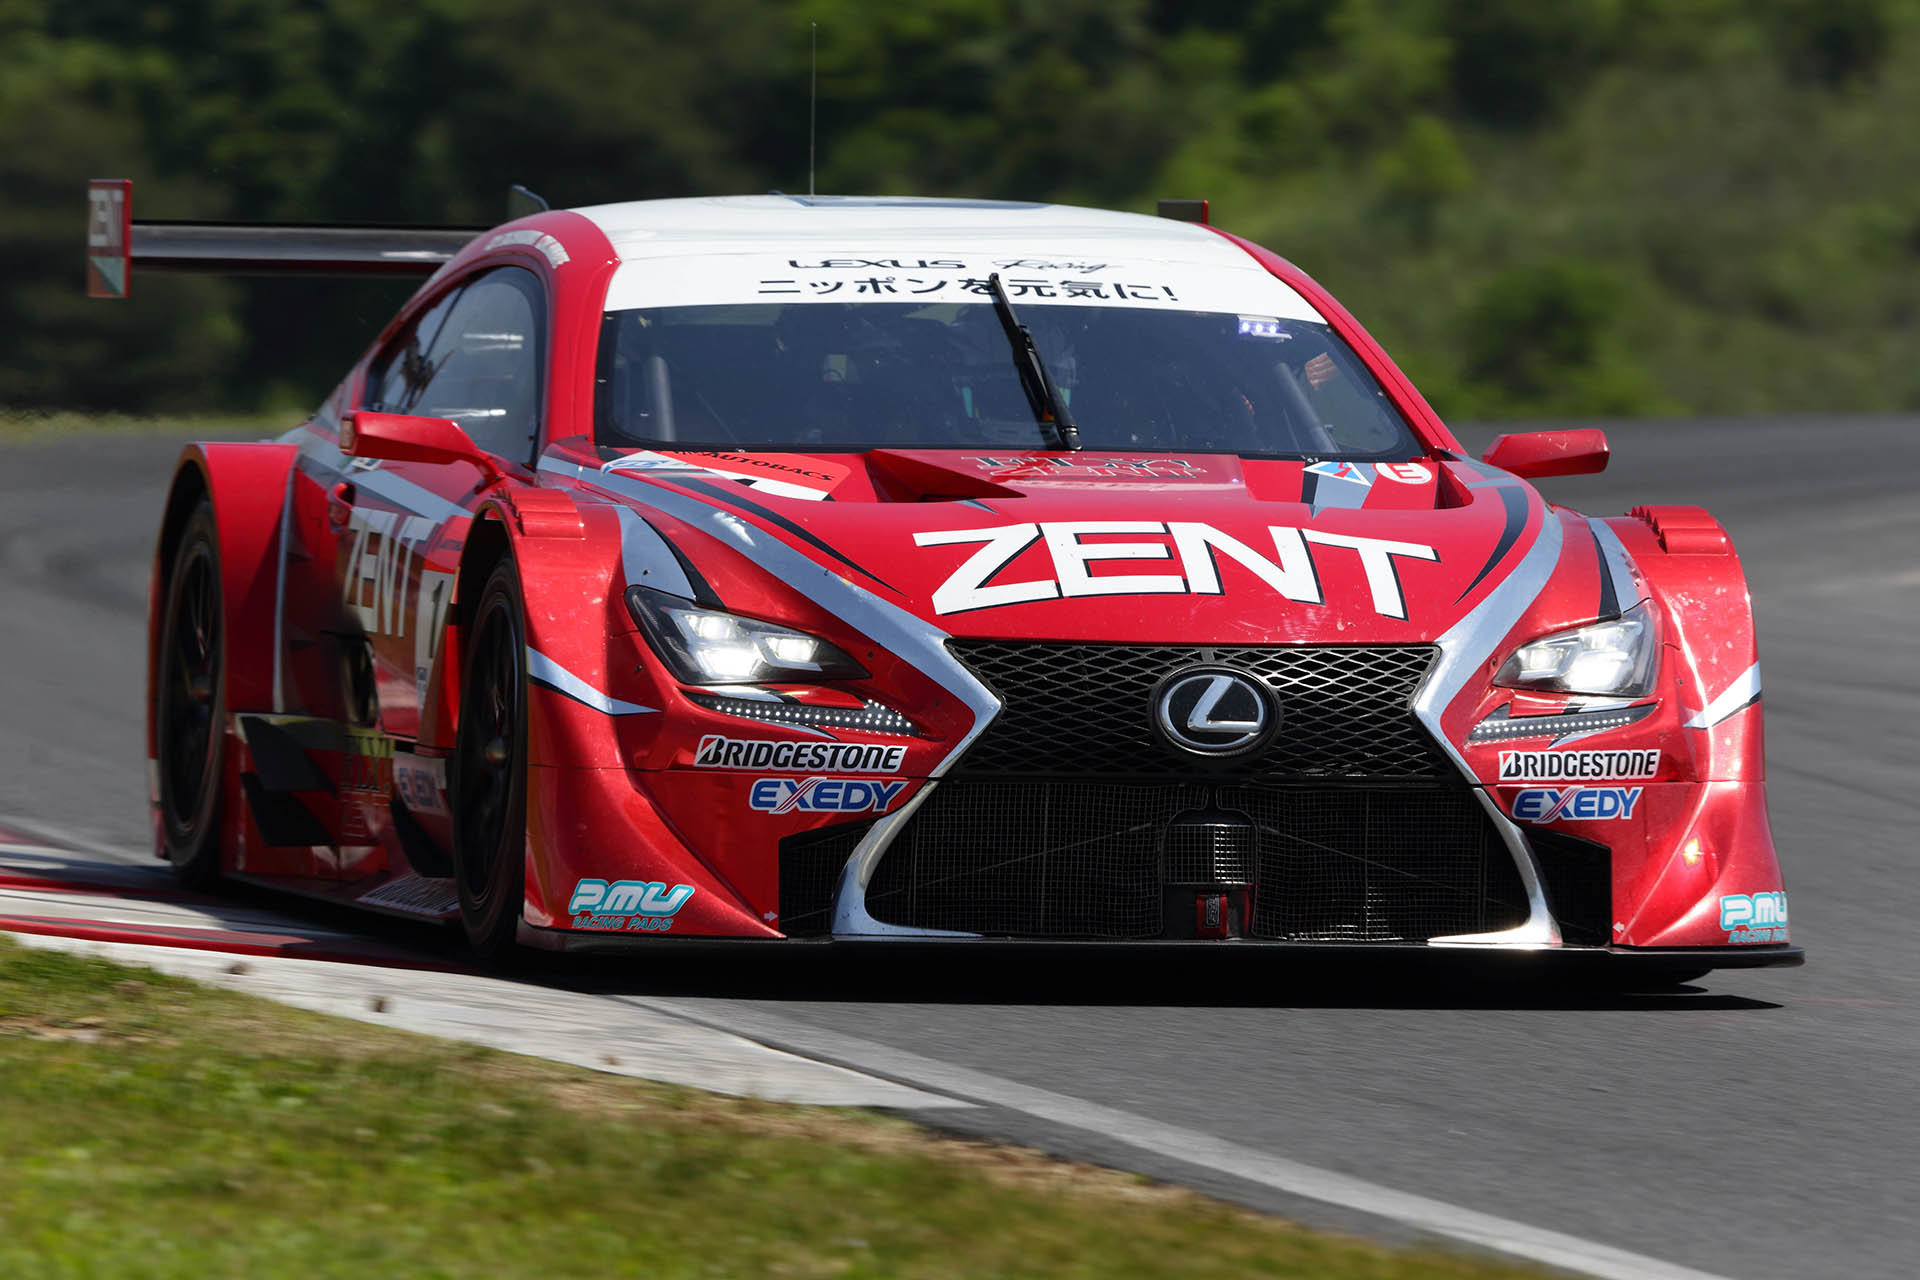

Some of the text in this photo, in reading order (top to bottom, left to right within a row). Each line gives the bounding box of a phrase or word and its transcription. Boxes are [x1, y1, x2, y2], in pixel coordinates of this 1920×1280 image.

[788, 259, 1118, 274] LEXUS Racing
[702, 451, 836, 482] AUTOBACS
[343, 506, 436, 638] ZENT
[912, 522, 1441, 621] ZENT
[697, 738, 905, 770] BRIDGESTONE
[1502, 752, 1657, 778] BRIDGESTONE
[751, 779, 905, 813] EXEDY
[1513, 788, 1641, 823] EXEDY
[572, 917, 673, 931] RACING PADS
